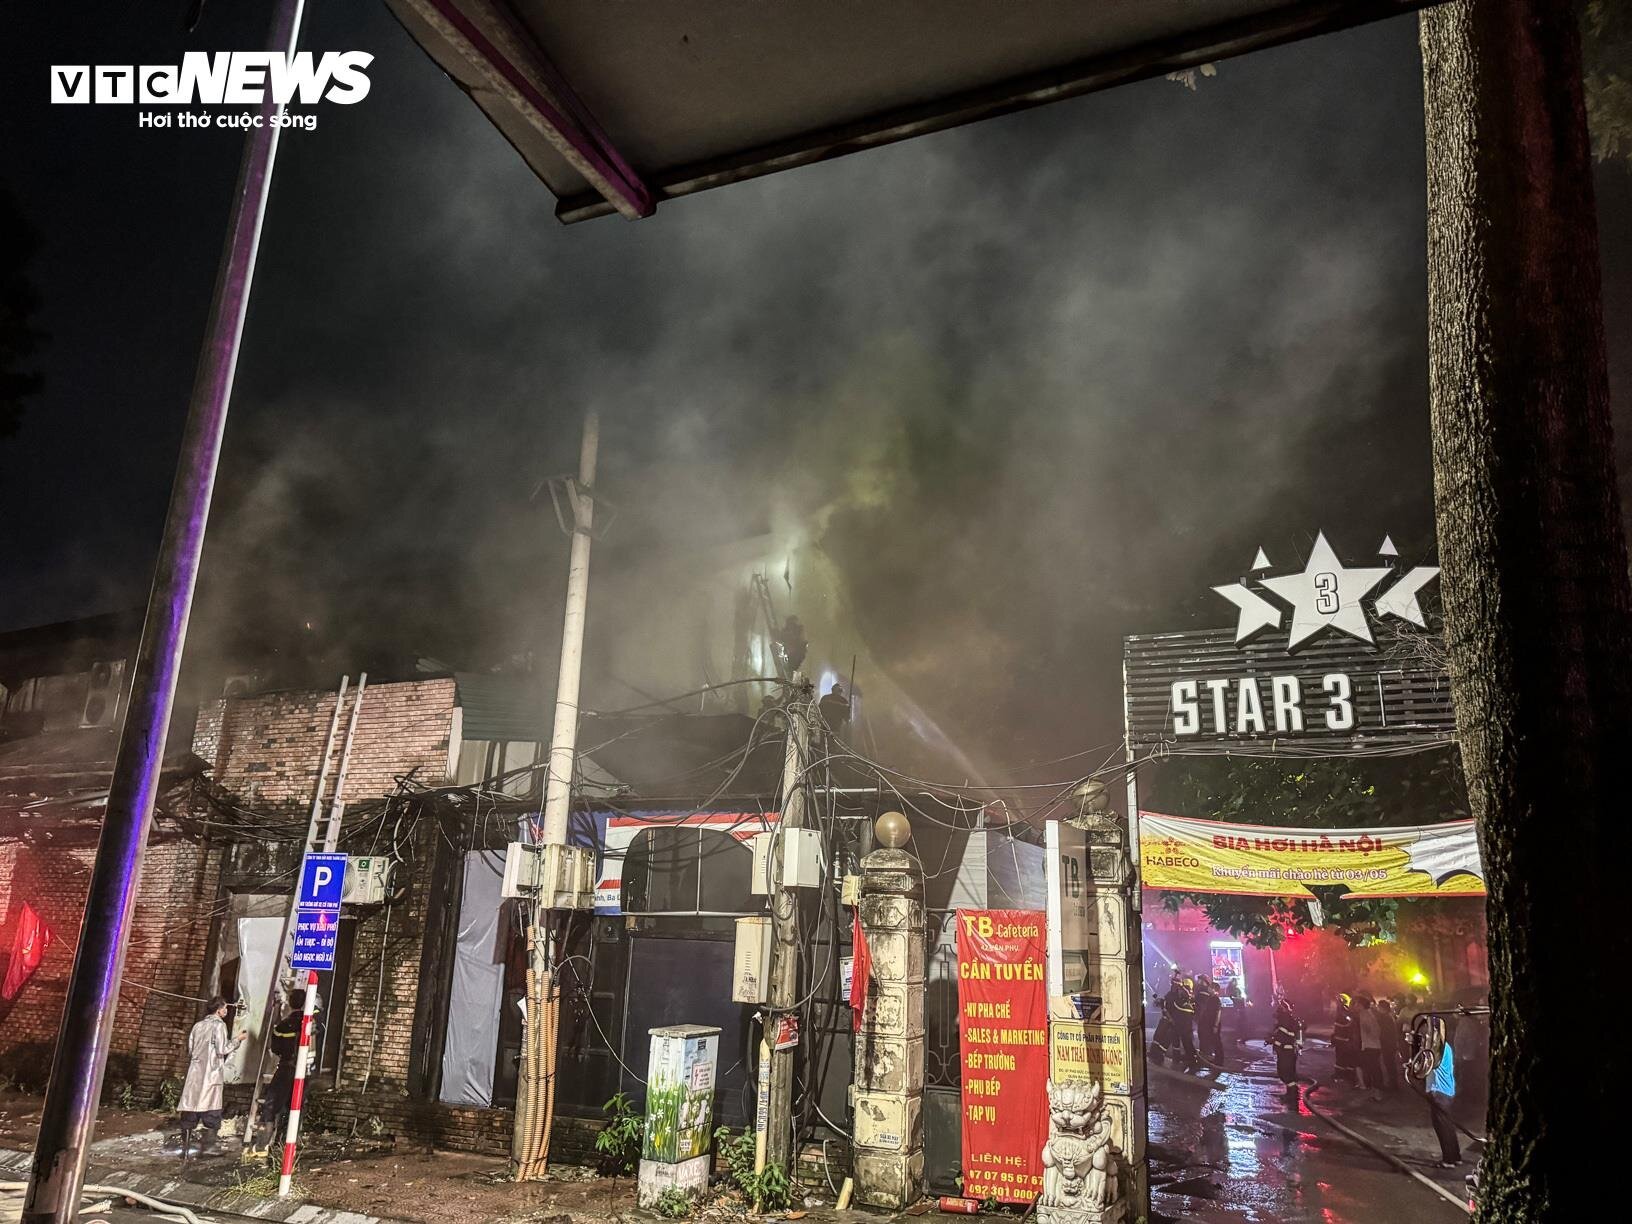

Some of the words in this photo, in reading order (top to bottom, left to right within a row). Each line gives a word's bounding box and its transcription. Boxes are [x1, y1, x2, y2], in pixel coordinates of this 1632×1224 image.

[1314, 571, 1340, 615] 3
[1171, 675, 1304, 735] STAR
[1322, 673, 1355, 732] 3
[1213, 835, 1250, 851] BIA
[1254, 837, 1297, 852] HƠI
[1301, 833, 1333, 852] HÀ
[1339, 832, 1383, 856] NỘI
[1146, 856, 1200, 868] HABECO
[312, 866, 332, 897] P
[1061, 855, 1079, 898] TB
[1212, 864, 1257, 880] Khuyến
[1257, 867, 1281, 879] mãi
[1281, 866, 1312, 880] chào
[1312, 866, 1329, 880] hè
[1330, 866, 1345, 879] từ
[1344, 868, 1388, 882] 03/05
[962, 915, 994, 938] TB
[960, 957, 991, 980] CẦN
[994, 956, 1044, 981] TUYỂN
[978, 1003, 994, 1018] PHA
[995, 999, 1011, 1019] CHẾ
[992, 1029, 999, 1044] &
[1000, 1030, 1045, 1045] MARKETING
[985, 1075, 1001, 1096] BẾP
[985, 1106, 996, 1126] VỤ
[971, 1152, 1002, 1164] LIÊN
[1005, 1155, 1027, 1168] HỆ:
[984, 1171, 998, 1181] 07
[1001, 1172, 1014, 1183] 95
[1016, 1174, 1028, 1184] 67
[969, 1184, 989, 1195] 092
